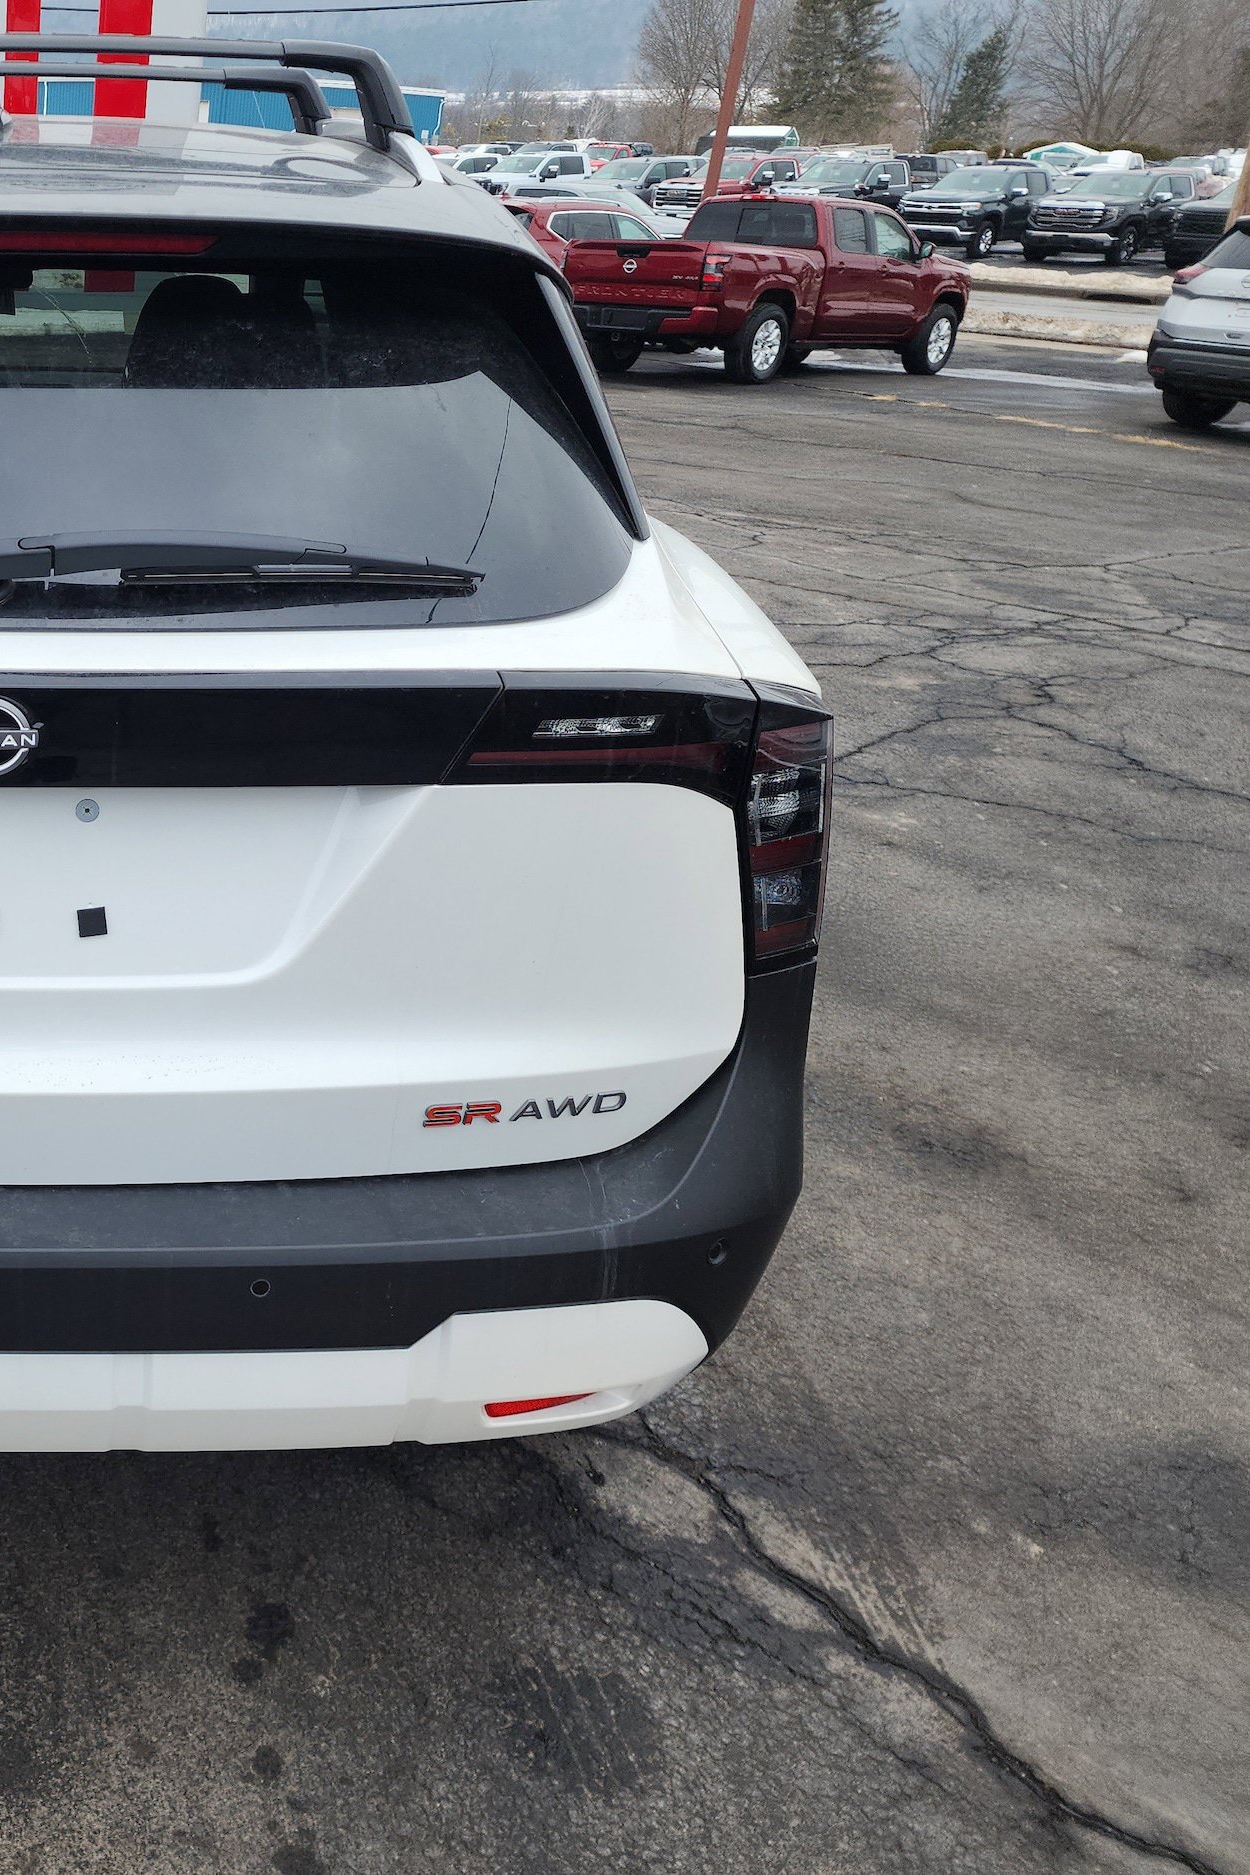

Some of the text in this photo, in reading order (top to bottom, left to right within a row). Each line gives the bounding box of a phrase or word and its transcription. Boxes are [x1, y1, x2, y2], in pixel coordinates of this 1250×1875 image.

[575, 285, 684, 300] FRONTIER
[422, 1089, 627, 1128] SR AWD
